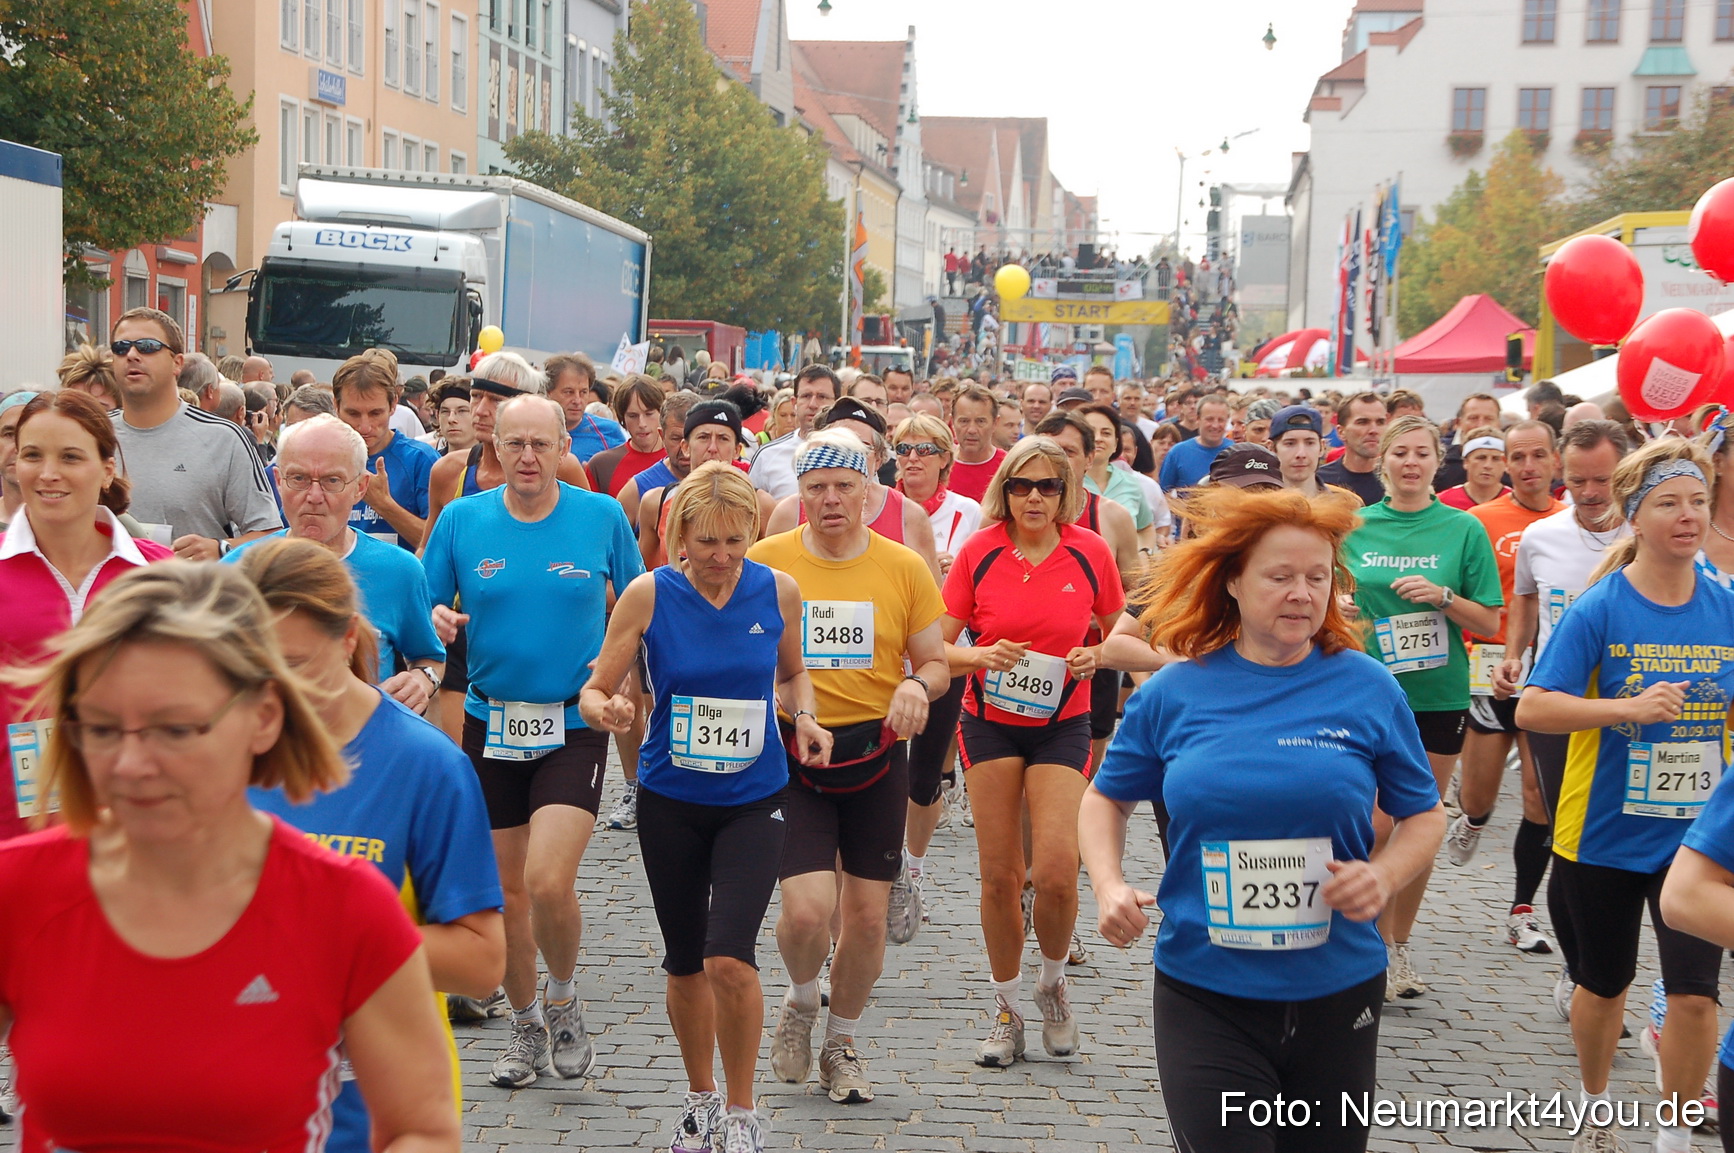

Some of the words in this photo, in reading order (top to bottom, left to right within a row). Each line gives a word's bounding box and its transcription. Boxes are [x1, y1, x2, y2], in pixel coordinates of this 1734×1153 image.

[315, 229, 413, 252] BOCK
[1054, 304, 1112, 318] START
[1647, 383, 1682, 402] NEU
[1361, 552, 1439, 572] Sinupret
[812, 606, 834, 619] Rudi
[1396, 617, 1438, 630] Alexandra
[813, 626, 864, 644] 3488
[1399, 632, 1440, 650] 2751
[1608, 644, 1632, 657] 10.
[1630, 658, 1722, 673] STADTLAUF
[1006, 672, 1053, 696] 3489
[698, 704, 722, 720] Olga
[508, 718, 554, 737] 6032
[697, 725, 751, 748] 3141
[1657, 750, 1700, 764] Martina
[1656, 771, 1711, 791] 2713
[1238, 851, 1306, 870] Susanne
[1242, 881, 1319, 909] 2337
